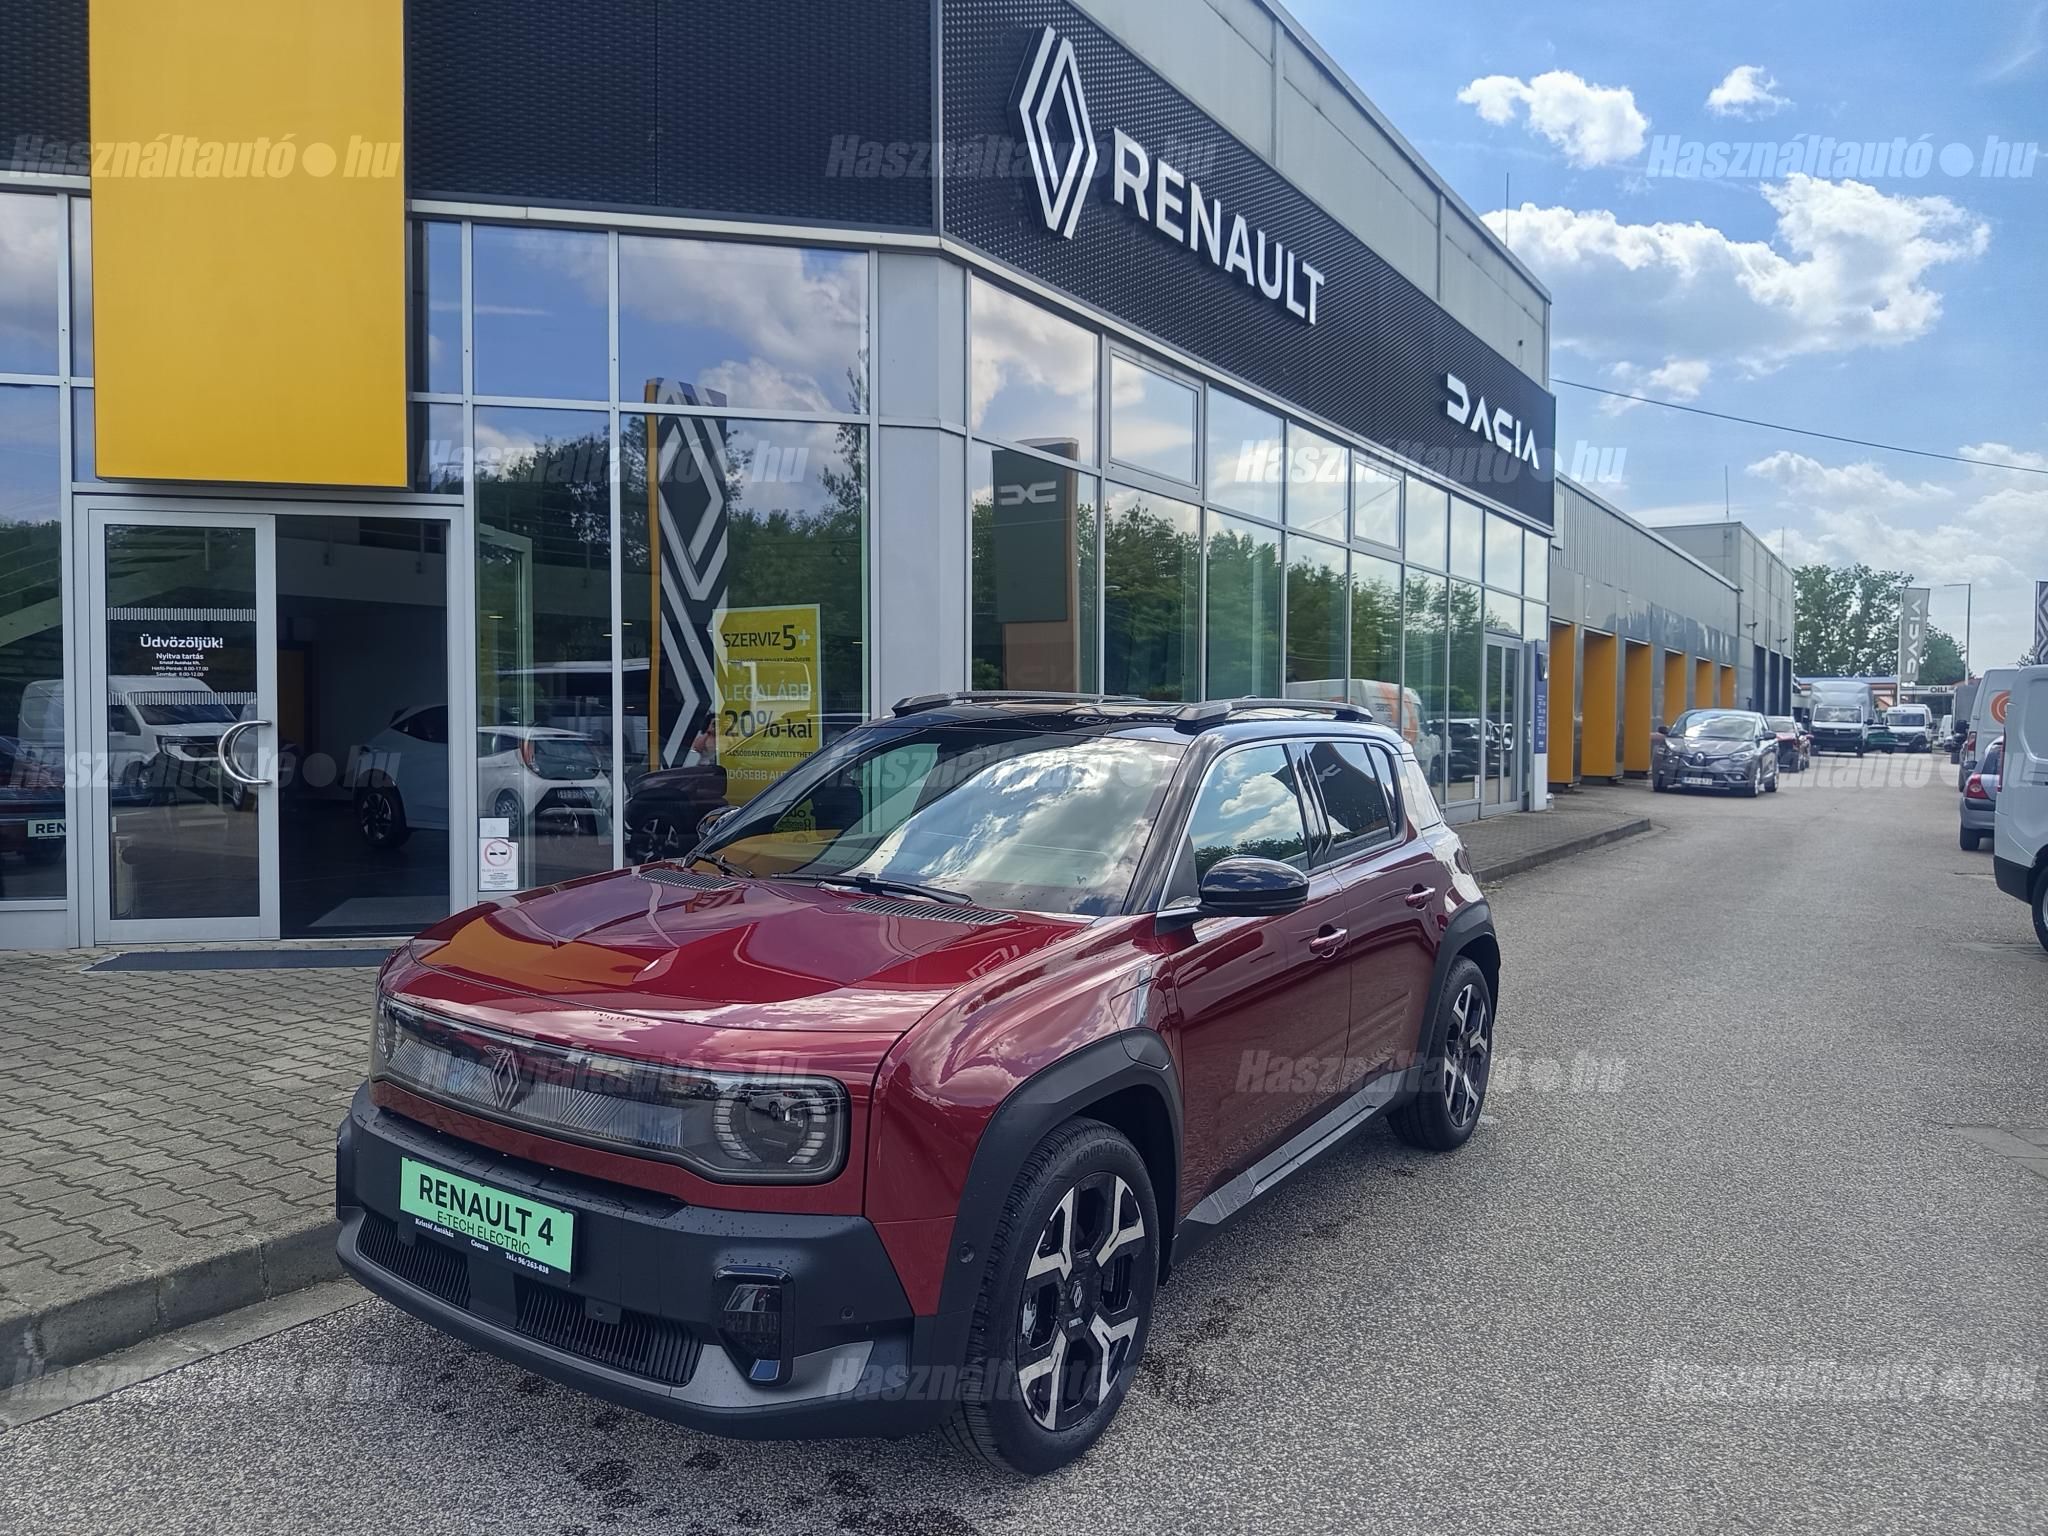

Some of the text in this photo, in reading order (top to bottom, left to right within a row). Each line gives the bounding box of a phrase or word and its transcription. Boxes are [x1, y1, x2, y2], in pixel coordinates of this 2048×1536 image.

[1114, 127, 1325, 326] RENAULT
[1446, 373, 1540, 471] DACIA
[140, 633, 224, 651] Üdvözöljük!
[156, 652, 204, 661] Nyitva tartás
[722, 631, 781, 648] SZERVIZ
[724, 710, 813, 738] 20%-kal
[419, 1173, 554, 1247] RENAULT 4
[437, 1211, 531, 1256] E-TECH ELECTRIC
